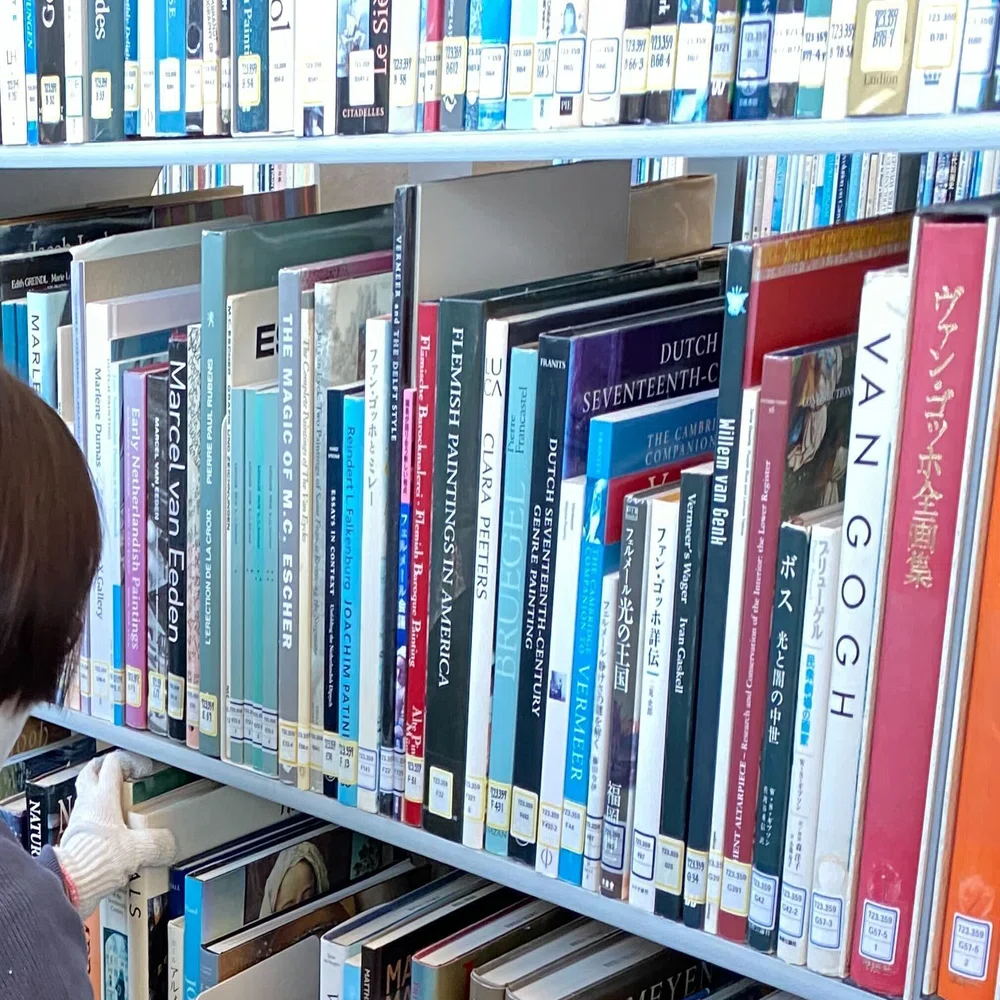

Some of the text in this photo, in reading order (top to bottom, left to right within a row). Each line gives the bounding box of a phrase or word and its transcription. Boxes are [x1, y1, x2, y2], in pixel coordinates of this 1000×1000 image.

[342, 106, 385, 118] CITADELLES
[375, 44, 388, 75] Le
[863, 73, 898, 86] Ludion
[390, 234, 403, 442] VERMEER and THE DELFT STYLE
[540, 358, 566, 369] FRANITS
[660, 332, 718, 365] DUTCH
[95, 424, 103, 468] Dumas
[205, 358, 214, 485] PIERRE PAUL RUBENS
[281, 312, 294, 651] THE MAGIC OF M.C. ESCHER
[346, 426, 356, 490] Reindert
[507, 385, 528, 455] Pierre Francastel
[711, 418, 735, 546] Willem van Genk
[129, 407, 142, 651] Early Netherlandish Paintings
[168, 361, 187, 643] Marcel van Eeden
[205, 508, 213, 545] CROIX
[328, 489, 337, 596] ESSAYS IN CONTEXT
[438, 327, 464, 688] FLEMISH PAINTINGS IN AMERICA
[475, 432, 496, 600] CLARA PEETERS
[829, 333, 892, 719] VAN GOGH
[343, 600, 352, 679] JOACHIM
[408, 509, 425, 669] Flemish Baroque Painting
[494, 483, 528, 681] BRUEGEL
[524, 504, 542, 651] GENRE PAINTING
[531, 437, 558, 718] DUTCH SEVENTEENTH-CENTURY
[613, 527, 636, 694] フェルメール光の王国
[647, 527, 667, 668] ファン・ゴッホ詳伝
[674, 493, 697, 694] Vermeer's Wager Ivan Gaskell
[777, 554, 798, 613] ボス
[734, 460, 771, 830] ALTARPIECE Research and Conservation the the Lower Register
[570, 664, 591, 782] VERMEER
